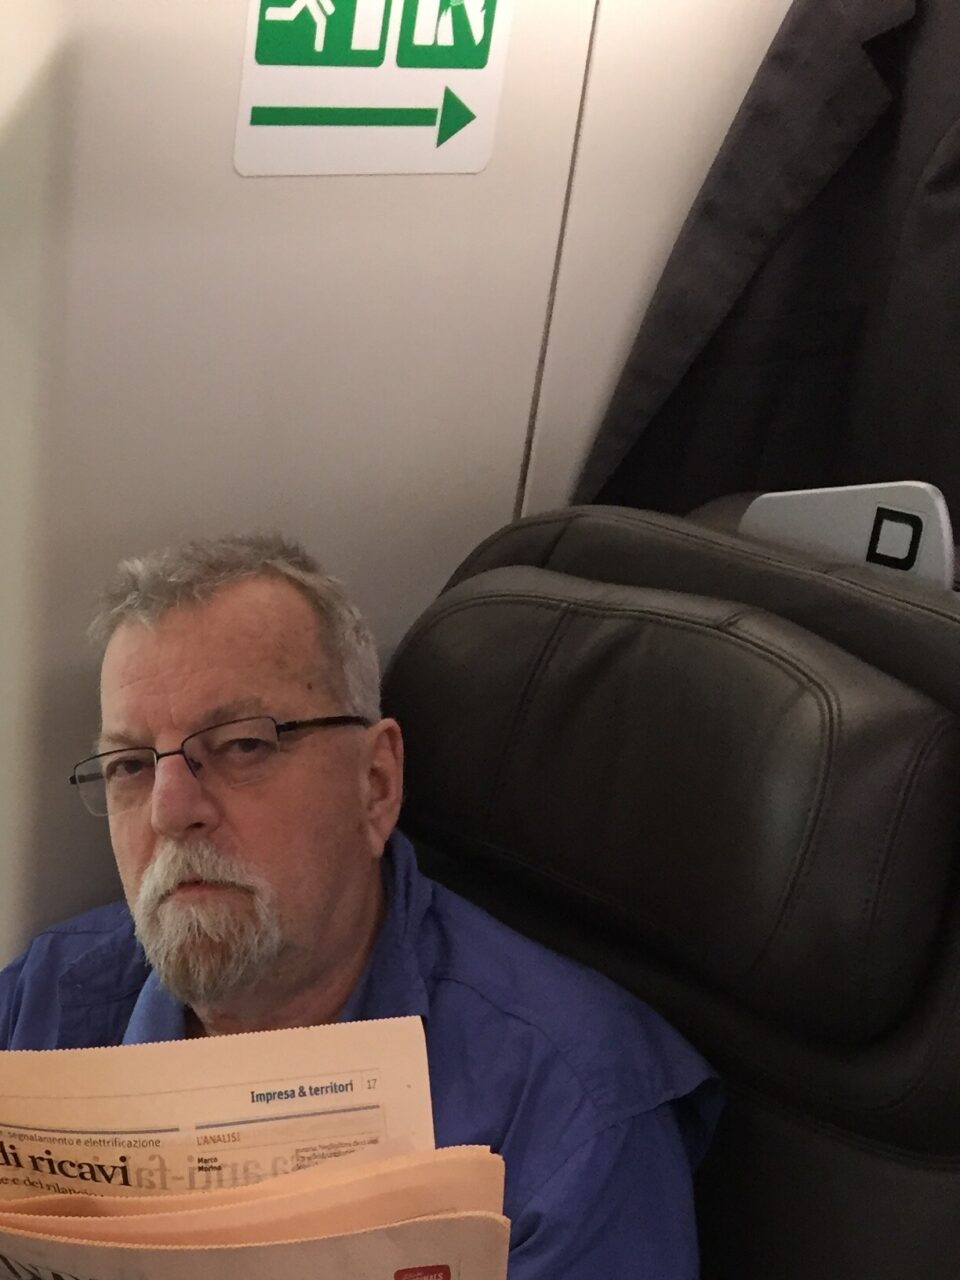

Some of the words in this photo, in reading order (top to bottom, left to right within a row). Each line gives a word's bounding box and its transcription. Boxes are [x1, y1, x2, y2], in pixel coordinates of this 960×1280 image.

[250, 1086, 296, 1104] Impresa
[298, 1085, 307, 1098] &
[309, 1080, 354, 1097] territori
[366, 1079, 377, 1090] 17
[83, 1137, 161, 1149] elettrificazione
[196, 1131, 241, 1146] L'ANALISI
[28, 1148, 133, 1188] ricavi
